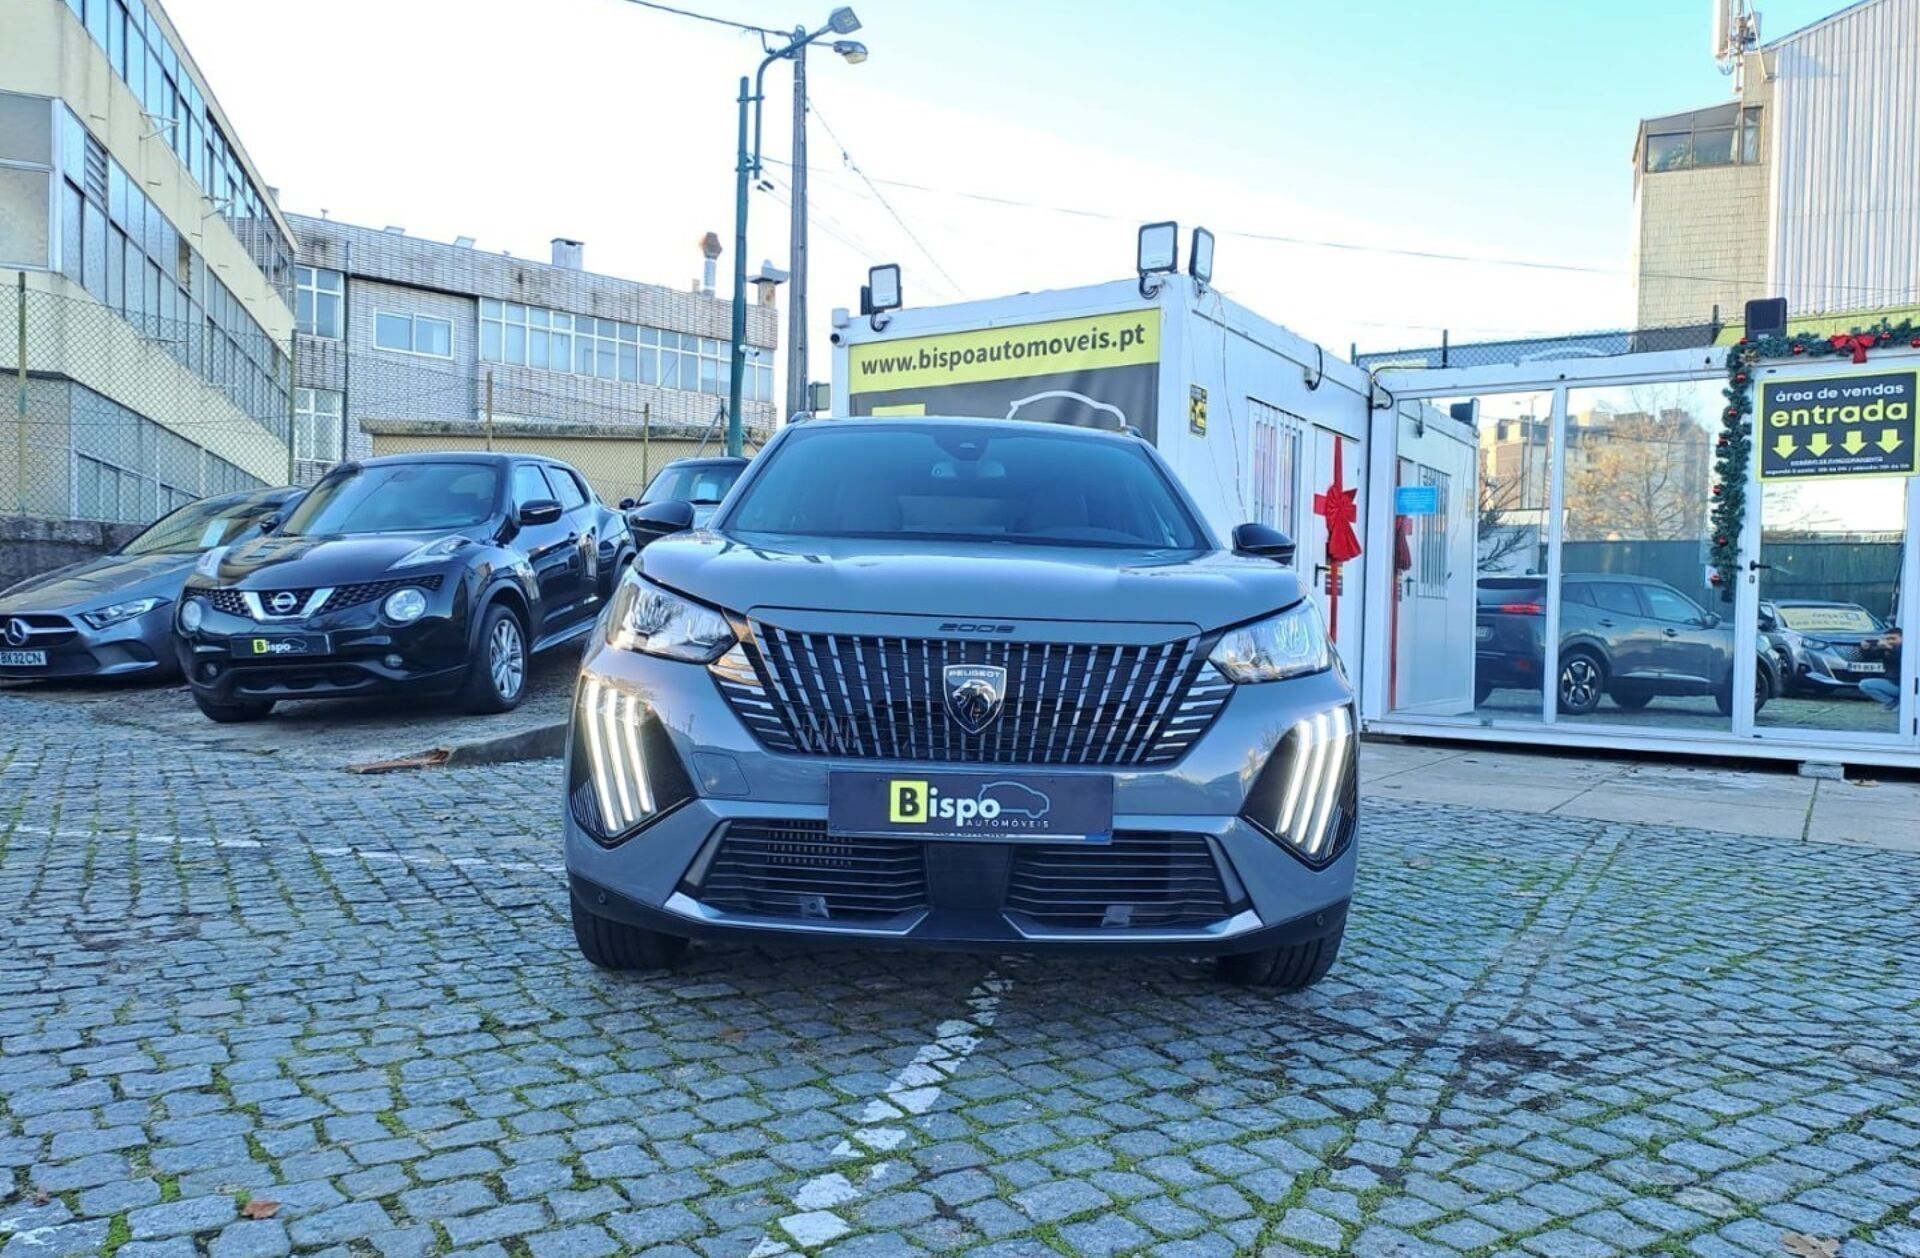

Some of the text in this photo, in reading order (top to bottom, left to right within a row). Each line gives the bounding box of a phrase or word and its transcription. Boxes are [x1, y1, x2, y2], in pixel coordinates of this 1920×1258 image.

[861, 323, 1146, 376] www.bispoautomoveis.pt
[1775, 384, 1904, 402] área de vendas
[1770, 398, 1908, 427] entrada
[938, 623, 1016, 633] 2008
[256, 640, 291, 653] Bispo
[948, 669, 1001, 678] PEUGEOT
[898, 786, 1001, 827] Bispo
[966, 818, 1050, 829] AUTOMÓVEIS
